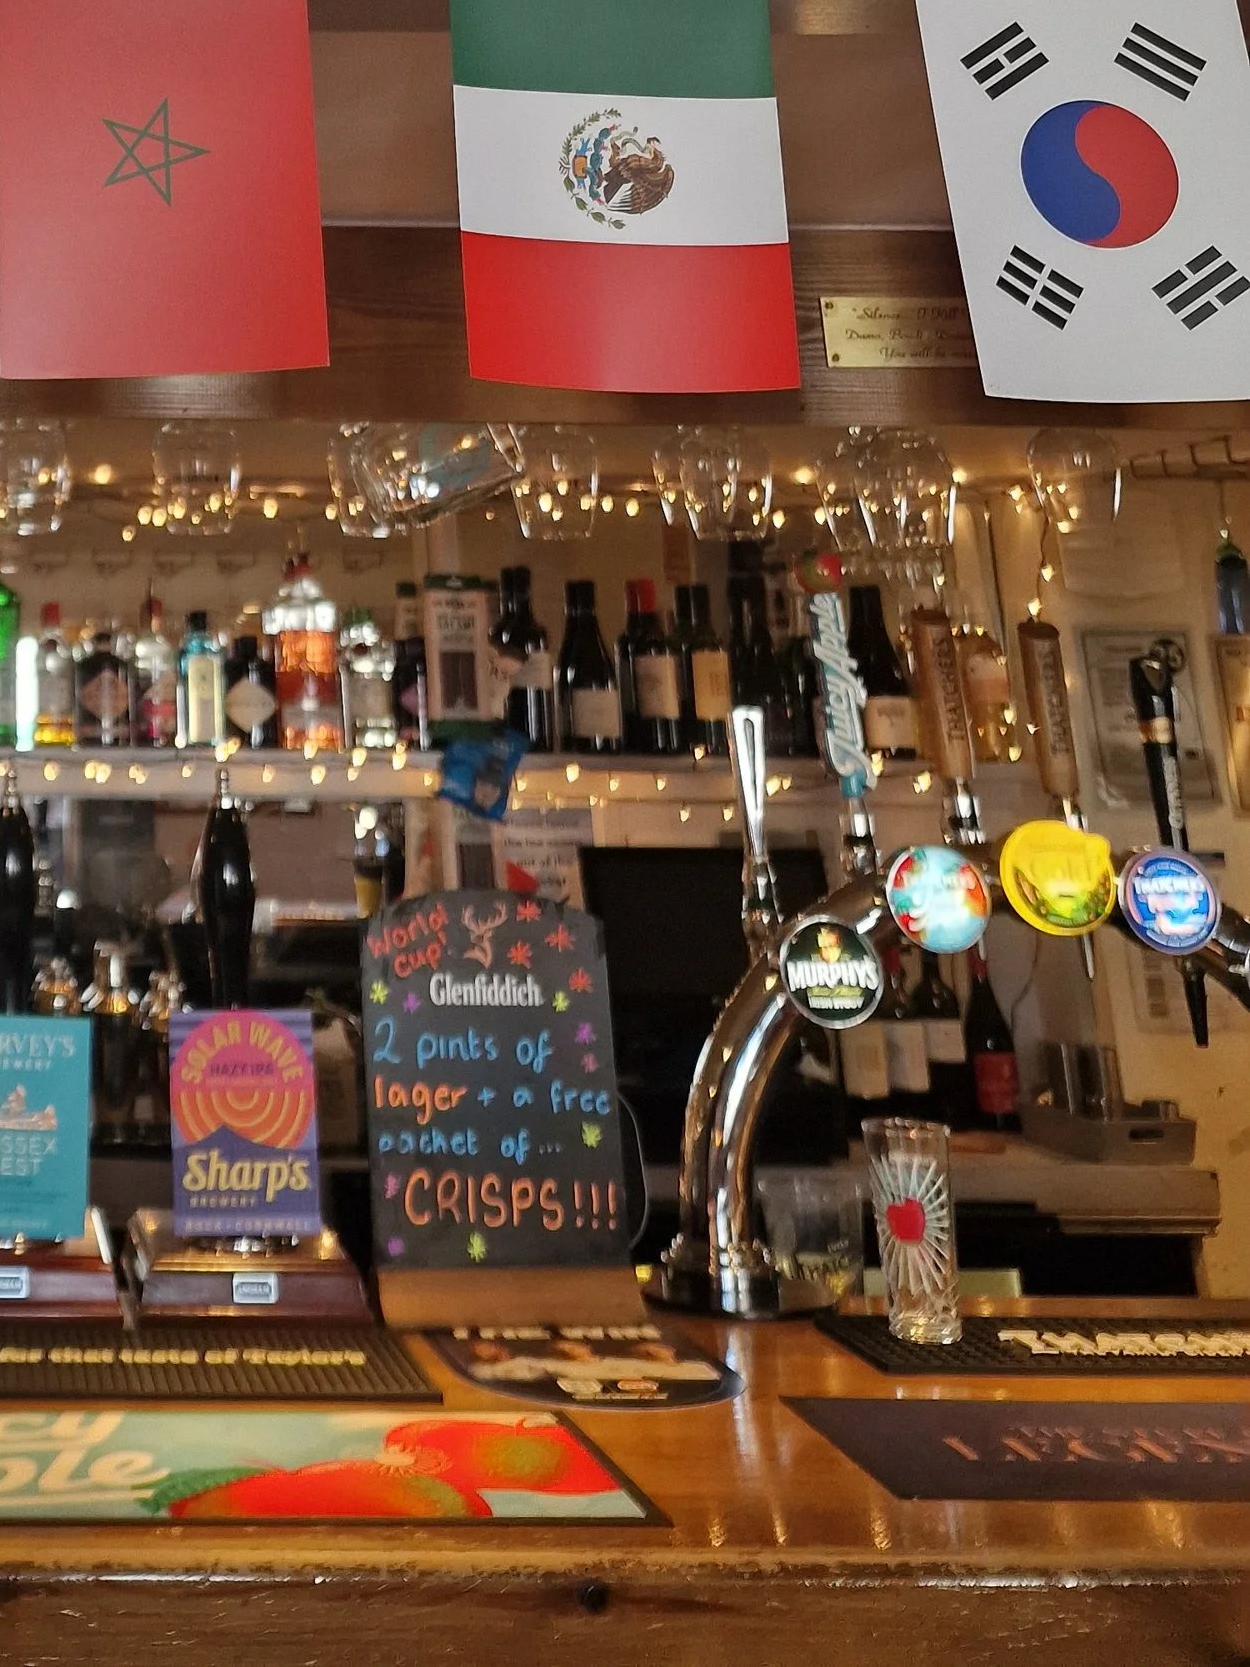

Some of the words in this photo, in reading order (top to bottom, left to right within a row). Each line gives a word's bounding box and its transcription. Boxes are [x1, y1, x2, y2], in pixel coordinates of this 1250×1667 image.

[809, 592, 868, 712] Apple
[366, 901, 449, 959] World
[429, 972, 544, 1008] Glenfiddich
[180, 1020, 242, 1084] SOLAR
[248, 1020, 304, 1084] WAVE
[210, 1062, 247, 1077] HAZY
[249, 1064, 275, 1076] IPA
[373, 1015, 401, 1065] 2
[416, 1027, 499, 1070] pints
[516, 1031, 554, 1075] of
[373, 1074, 469, 1125] lager
[512, 1086, 533, 1108] a
[550, 1080, 612, 1117] free
[182, 1149, 311, 1203] Sharp's
[189, 1196, 256, 1208] BREWERY
[403, 1167, 618, 1231] CRISPS!!!
